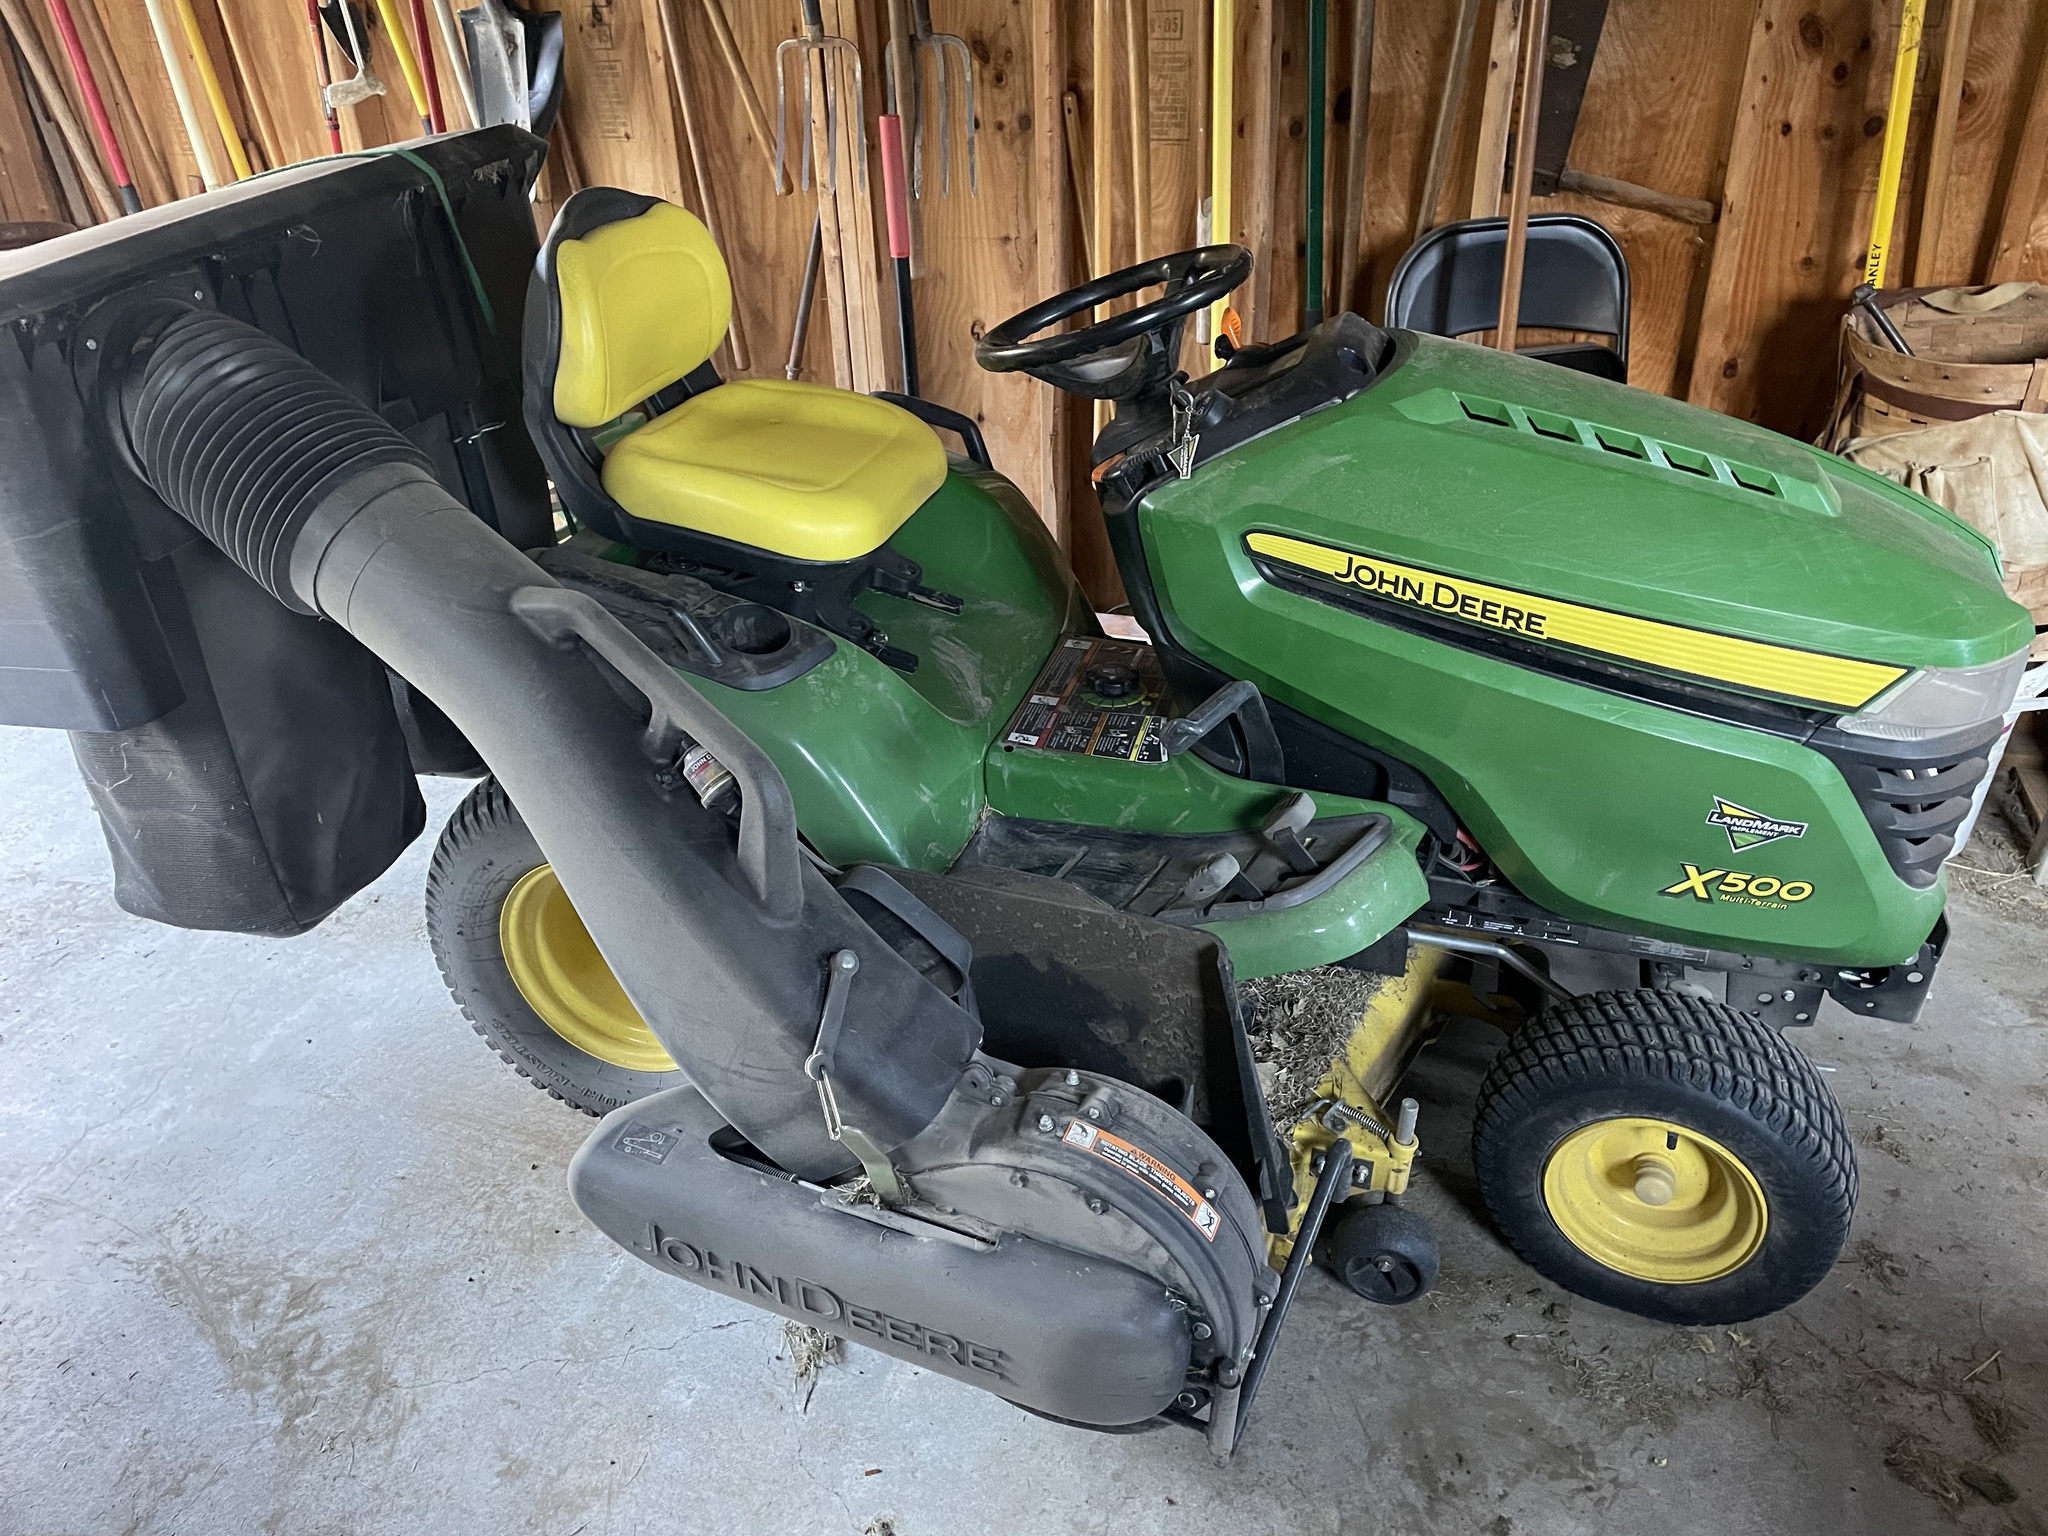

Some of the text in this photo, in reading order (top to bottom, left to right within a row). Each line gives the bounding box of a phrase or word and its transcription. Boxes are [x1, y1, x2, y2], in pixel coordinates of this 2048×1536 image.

[1867, 244, 1881, 287] ANLEY
[1334, 557, 1547, 636] JOHN DEERE
[691, 756, 707, 772] JOHN
[1710, 813, 1802, 836] LANDMARK
[1730, 825, 1780, 838] IMPLEMENT
[1661, 862, 1814, 903] X500
[1719, 894, 1788, 910] Multi-Terrain
[1100, 1139, 1128, 1157] ROTATING
[1129, 1152, 1148, 1169] BLADE
[1150, 1167, 1174, 1188] THROWN
[1173, 1184, 1196, 1207] OBJECTS
[1138, 1151, 1176, 1182] WARNING
[630, 1221, 1006, 1376] JOHN DEERE
